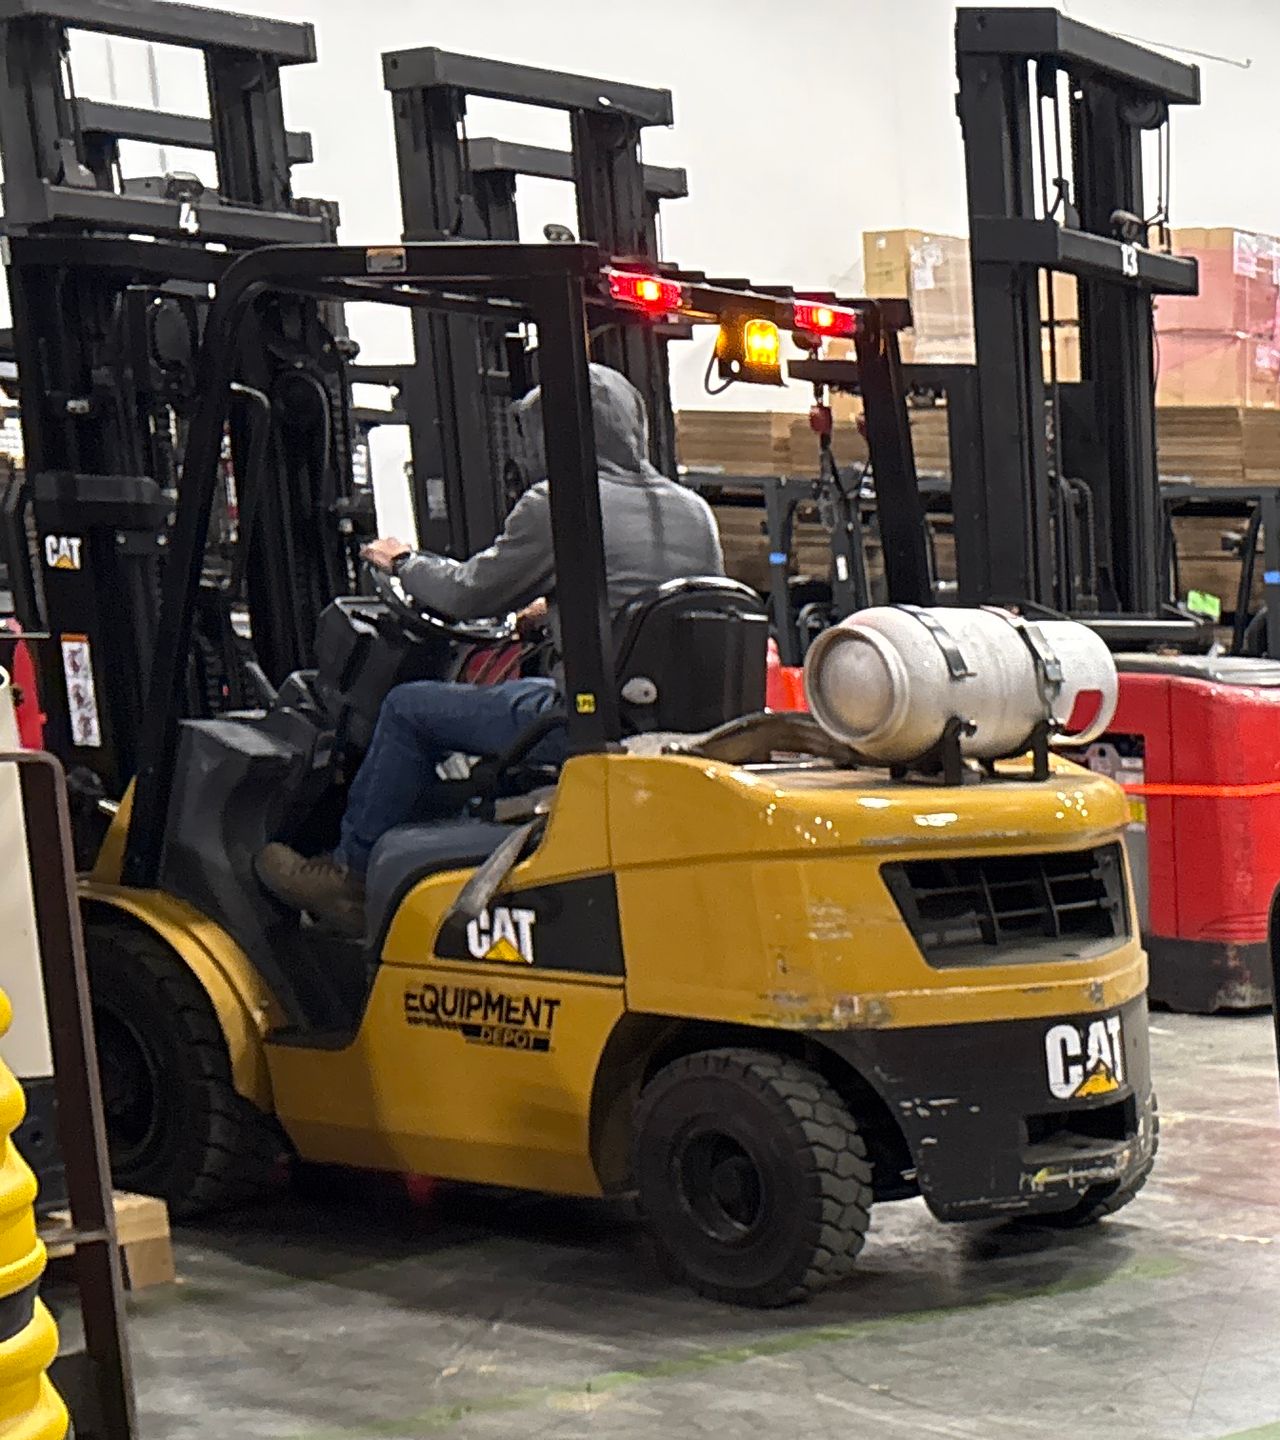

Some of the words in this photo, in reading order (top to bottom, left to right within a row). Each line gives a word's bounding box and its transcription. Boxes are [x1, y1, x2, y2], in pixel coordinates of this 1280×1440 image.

[179, 202, 199, 234] 4
[1121, 243, 1138, 277] 13
[45, 535, 81, 570] CAT
[466, 907, 536, 965] CAT
[404, 983, 562, 1030] EQUIPMENT
[480, 1025, 533, 1050] DEPOT
[1045, 1015, 1123, 1100] CAT
